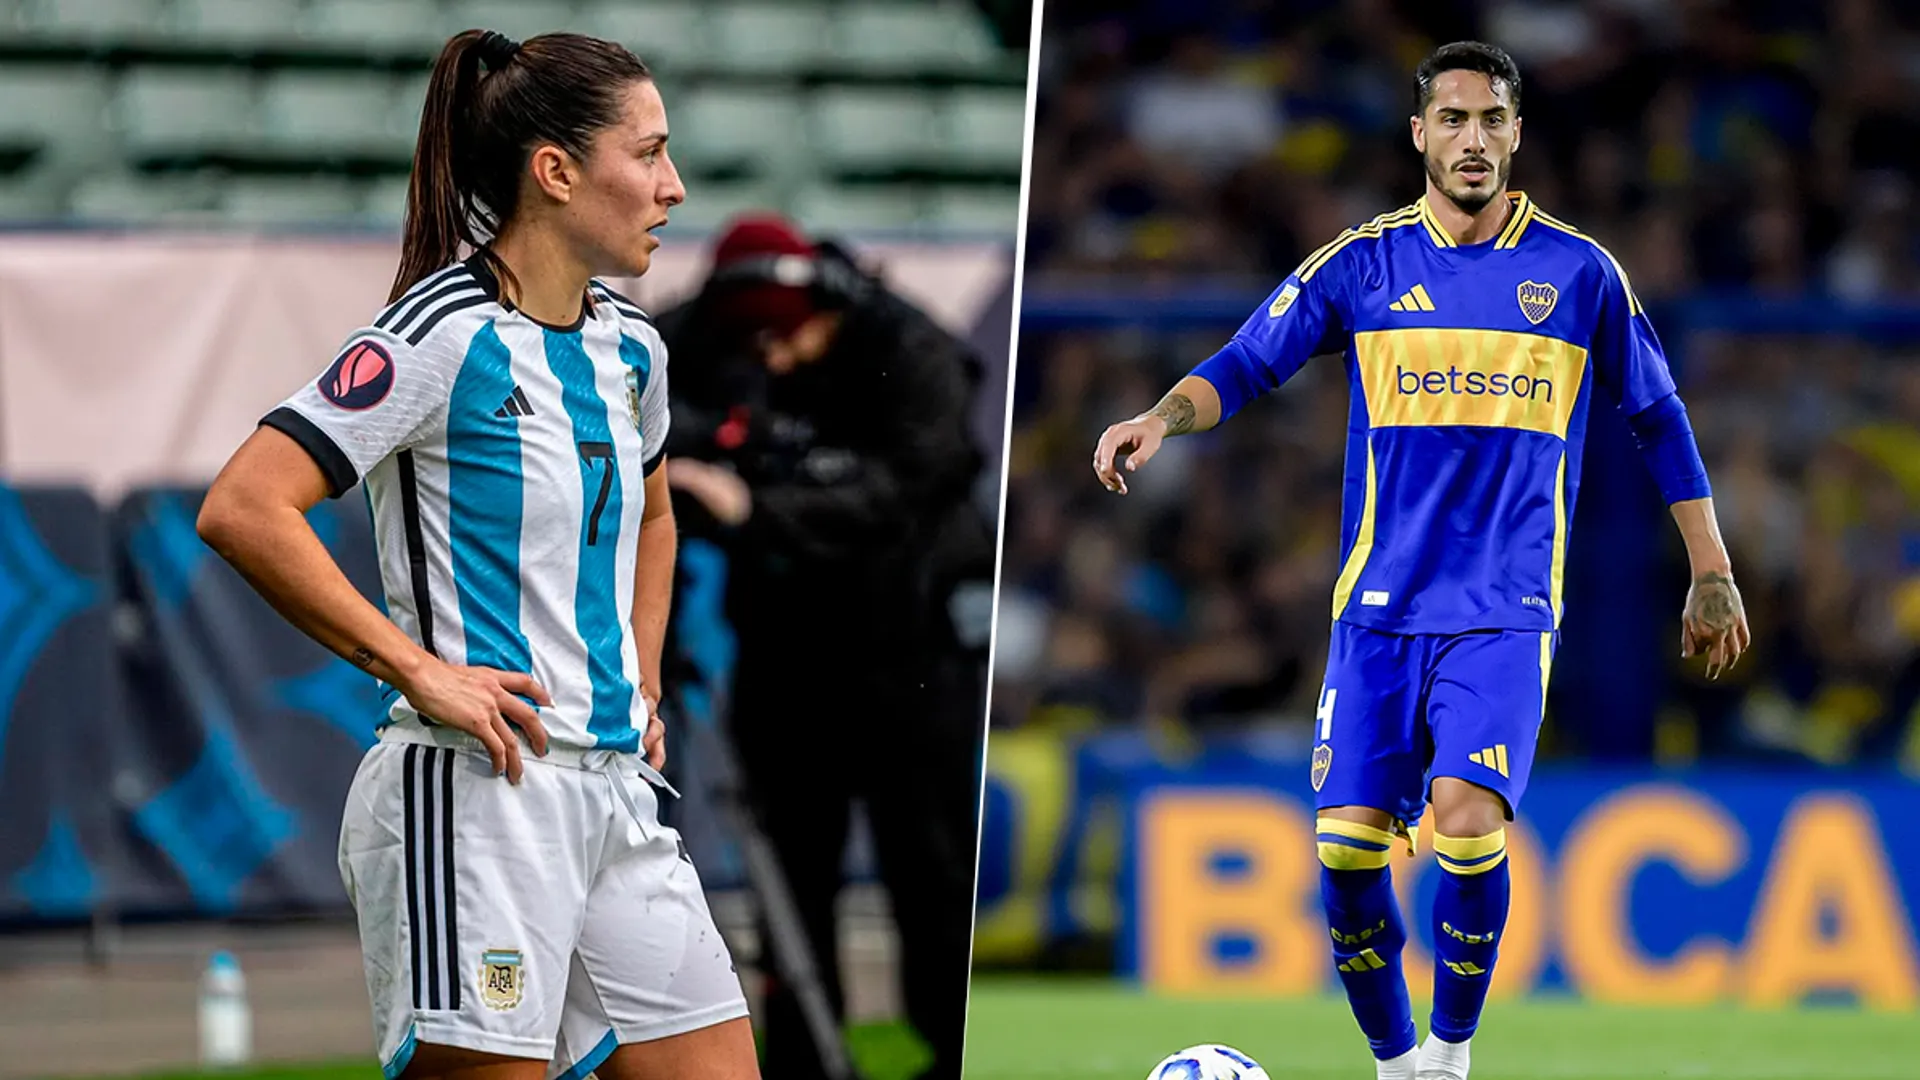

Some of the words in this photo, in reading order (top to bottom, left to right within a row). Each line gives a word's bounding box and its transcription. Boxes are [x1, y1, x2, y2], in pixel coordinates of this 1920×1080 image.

[1396, 365, 1553, 402] betsson
[578, 441, 614, 546] 7
[1316, 682, 1337, 740] 4
